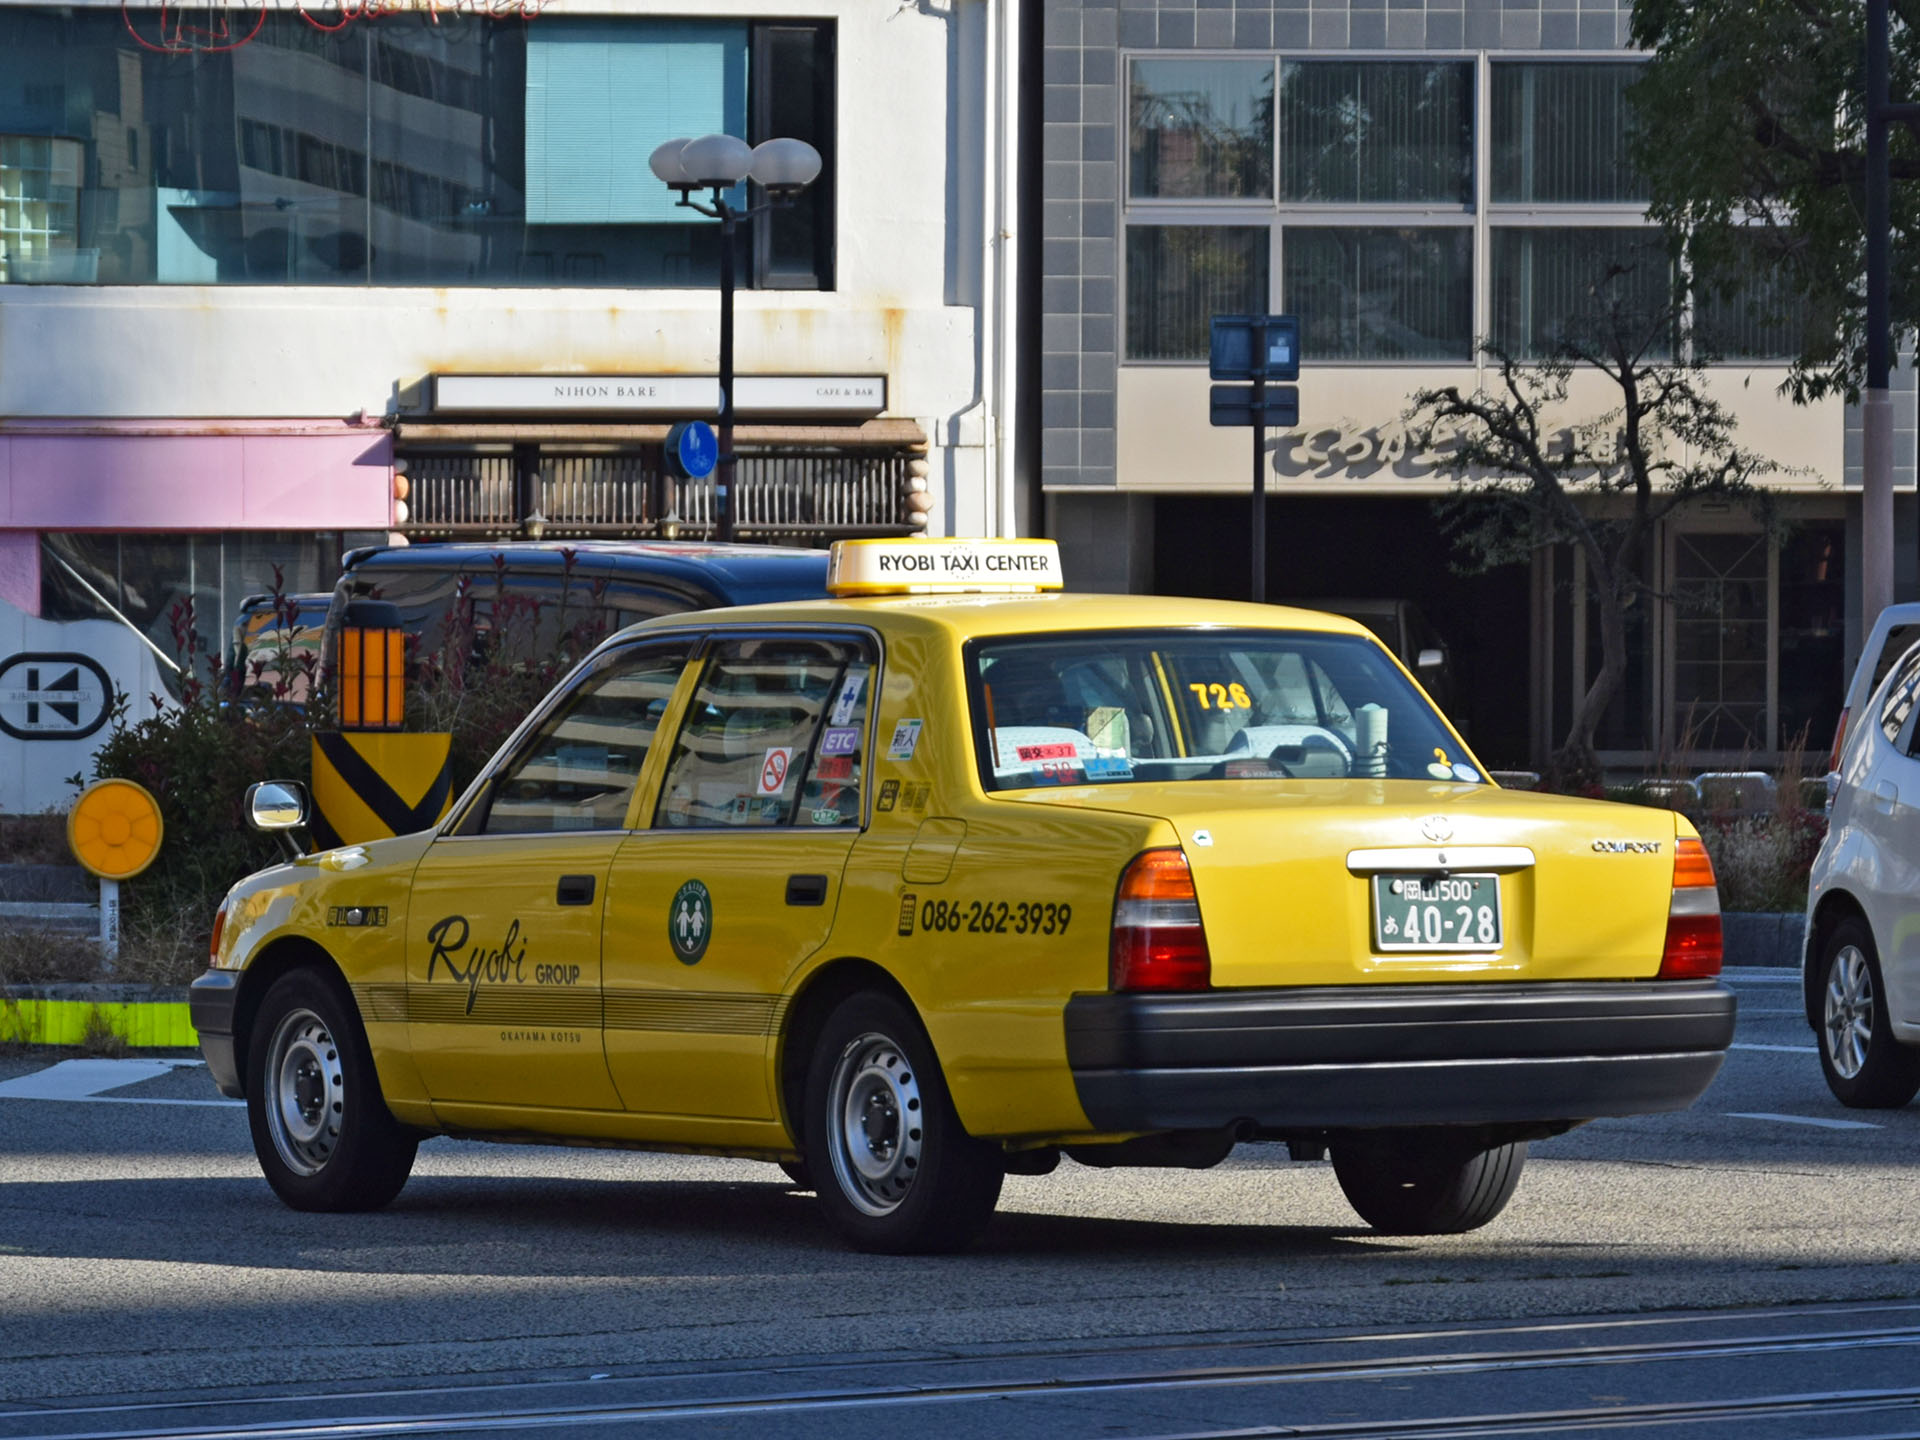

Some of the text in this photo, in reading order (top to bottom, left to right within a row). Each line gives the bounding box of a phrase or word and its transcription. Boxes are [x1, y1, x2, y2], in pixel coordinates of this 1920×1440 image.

[554, 386, 657, 397] NIHON BARE
[816, 388, 841, 397] CAFE
[855, 388, 874, 397] BAR
[879, 555, 1048, 571] RYOBI TAXI CENTER
[1189, 683, 1252, 709] 726
[825, 733, 855, 750] ETC
[892, 729, 915, 748] 新人
[1434, 748, 1451, 767] 2
[1591, 840, 1661, 853] COMFORT
[921, 900, 1072, 935] 086-262-3939
[1383, 905, 1495, 943] あ 40-28
[427, 915, 580, 1016] Ryobi GROUP
[500, 1032, 581, 1043] OKAYAMA KOTSU
